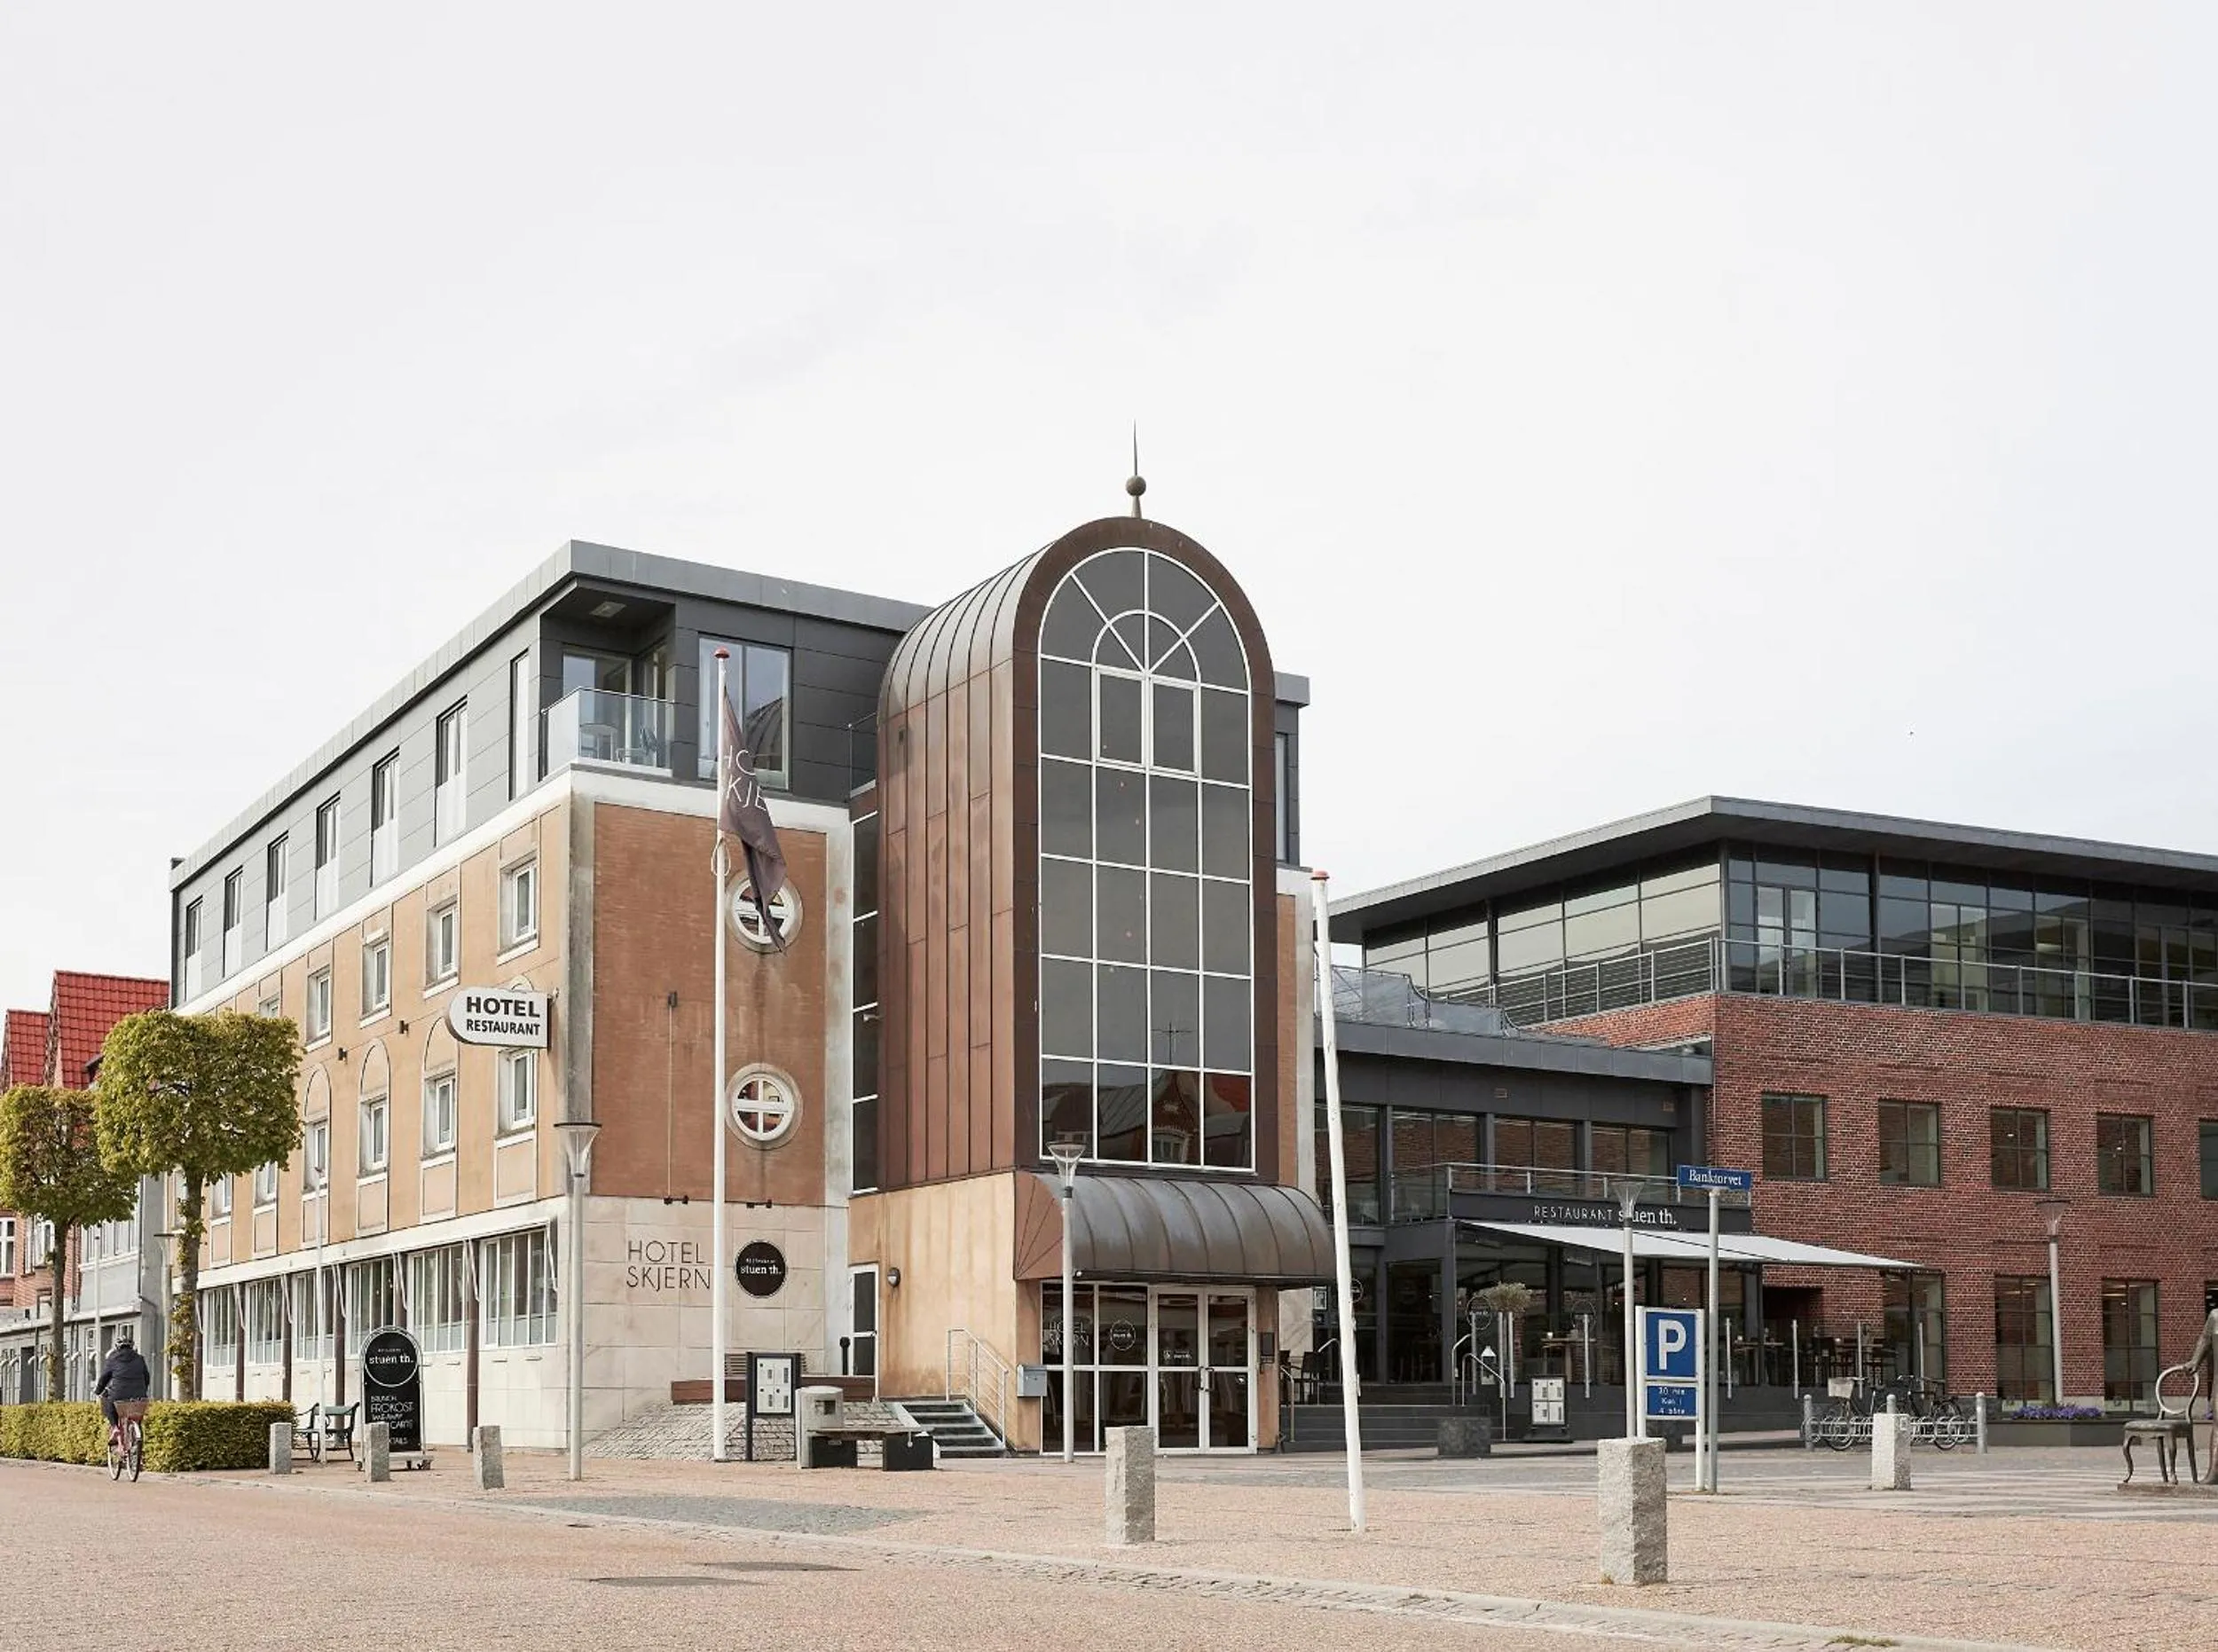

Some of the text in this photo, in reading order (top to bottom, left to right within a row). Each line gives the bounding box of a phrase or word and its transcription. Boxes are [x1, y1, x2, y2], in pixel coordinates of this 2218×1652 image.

[466, 995, 540, 1019] HOTEL
[466, 1019, 540, 1036] RESTAURANT
[1688, 1168, 1742, 1186] Banktorvet
[1534, 1204, 1678, 1225] RESTAURANT suen th.
[627, 1240, 705, 1264] HOTEL
[625, 1265, 711, 1293] SKJERN
[1658, 1318, 1687, 1371] P
[368, 1354, 397, 1365] stuen
